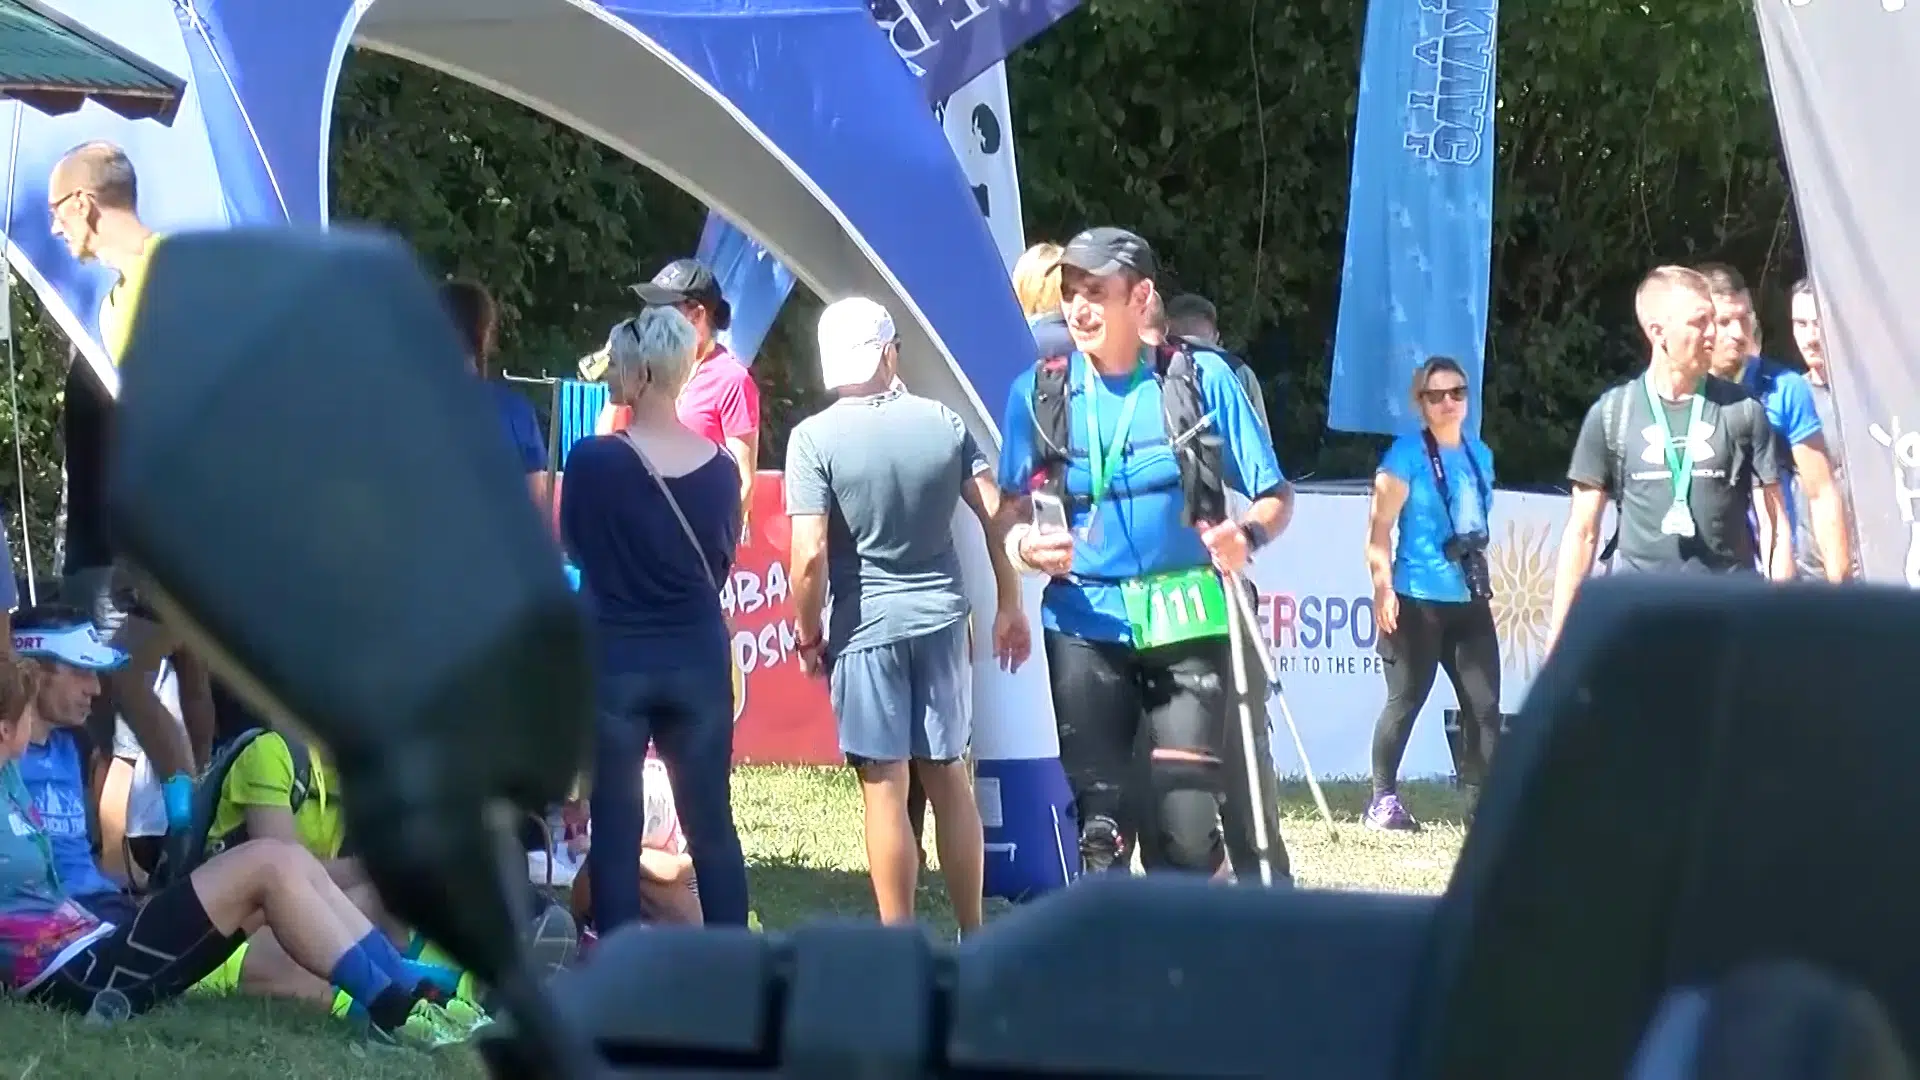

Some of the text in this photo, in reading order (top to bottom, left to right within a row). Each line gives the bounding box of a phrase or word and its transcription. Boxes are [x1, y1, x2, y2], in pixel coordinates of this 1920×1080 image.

[719, 561, 792, 617] ABA
[1304, 657, 1320, 674] TO
[1327, 657, 1355, 674] THE
[1363, 657, 1381, 674] PE
